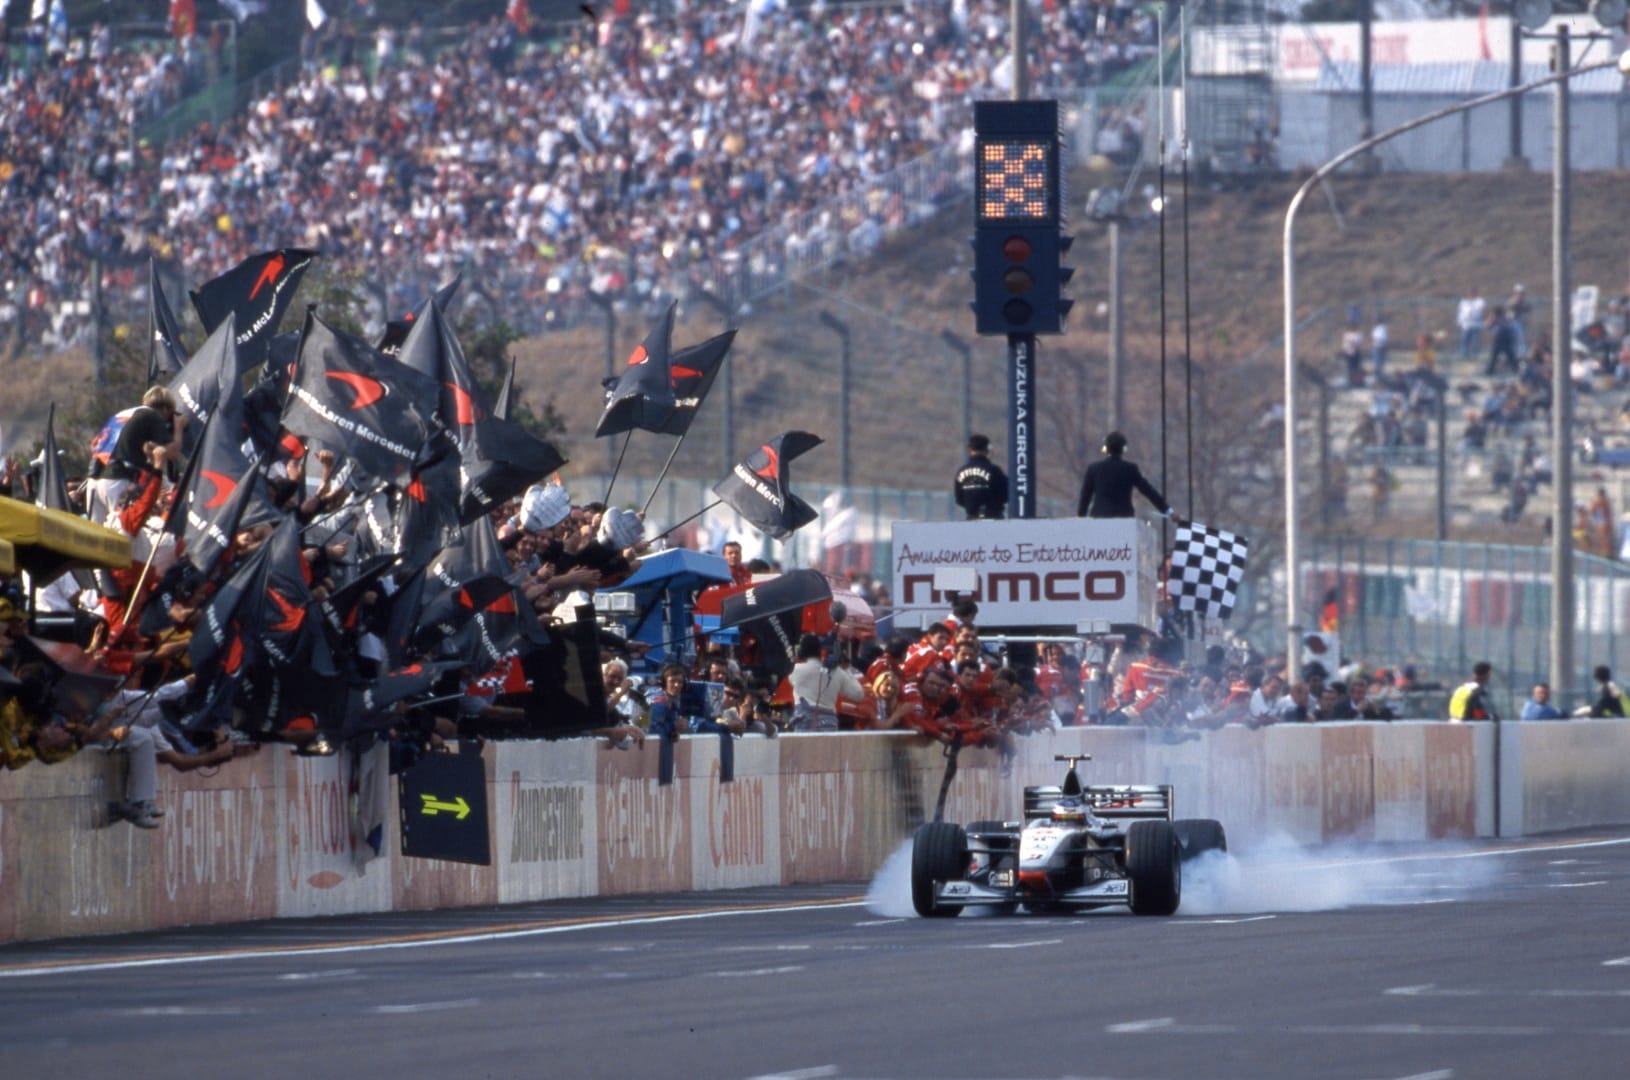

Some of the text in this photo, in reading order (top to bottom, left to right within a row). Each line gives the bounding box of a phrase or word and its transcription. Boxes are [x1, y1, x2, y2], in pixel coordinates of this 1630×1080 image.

[1016, 341, 1028, 495] SUZUKA CIRCUIT
[897, 543, 1132, 572] Amusement to Entertainment
[511, 771, 584, 864] BRIDGESTONE
[708, 757, 764, 869] Canon
